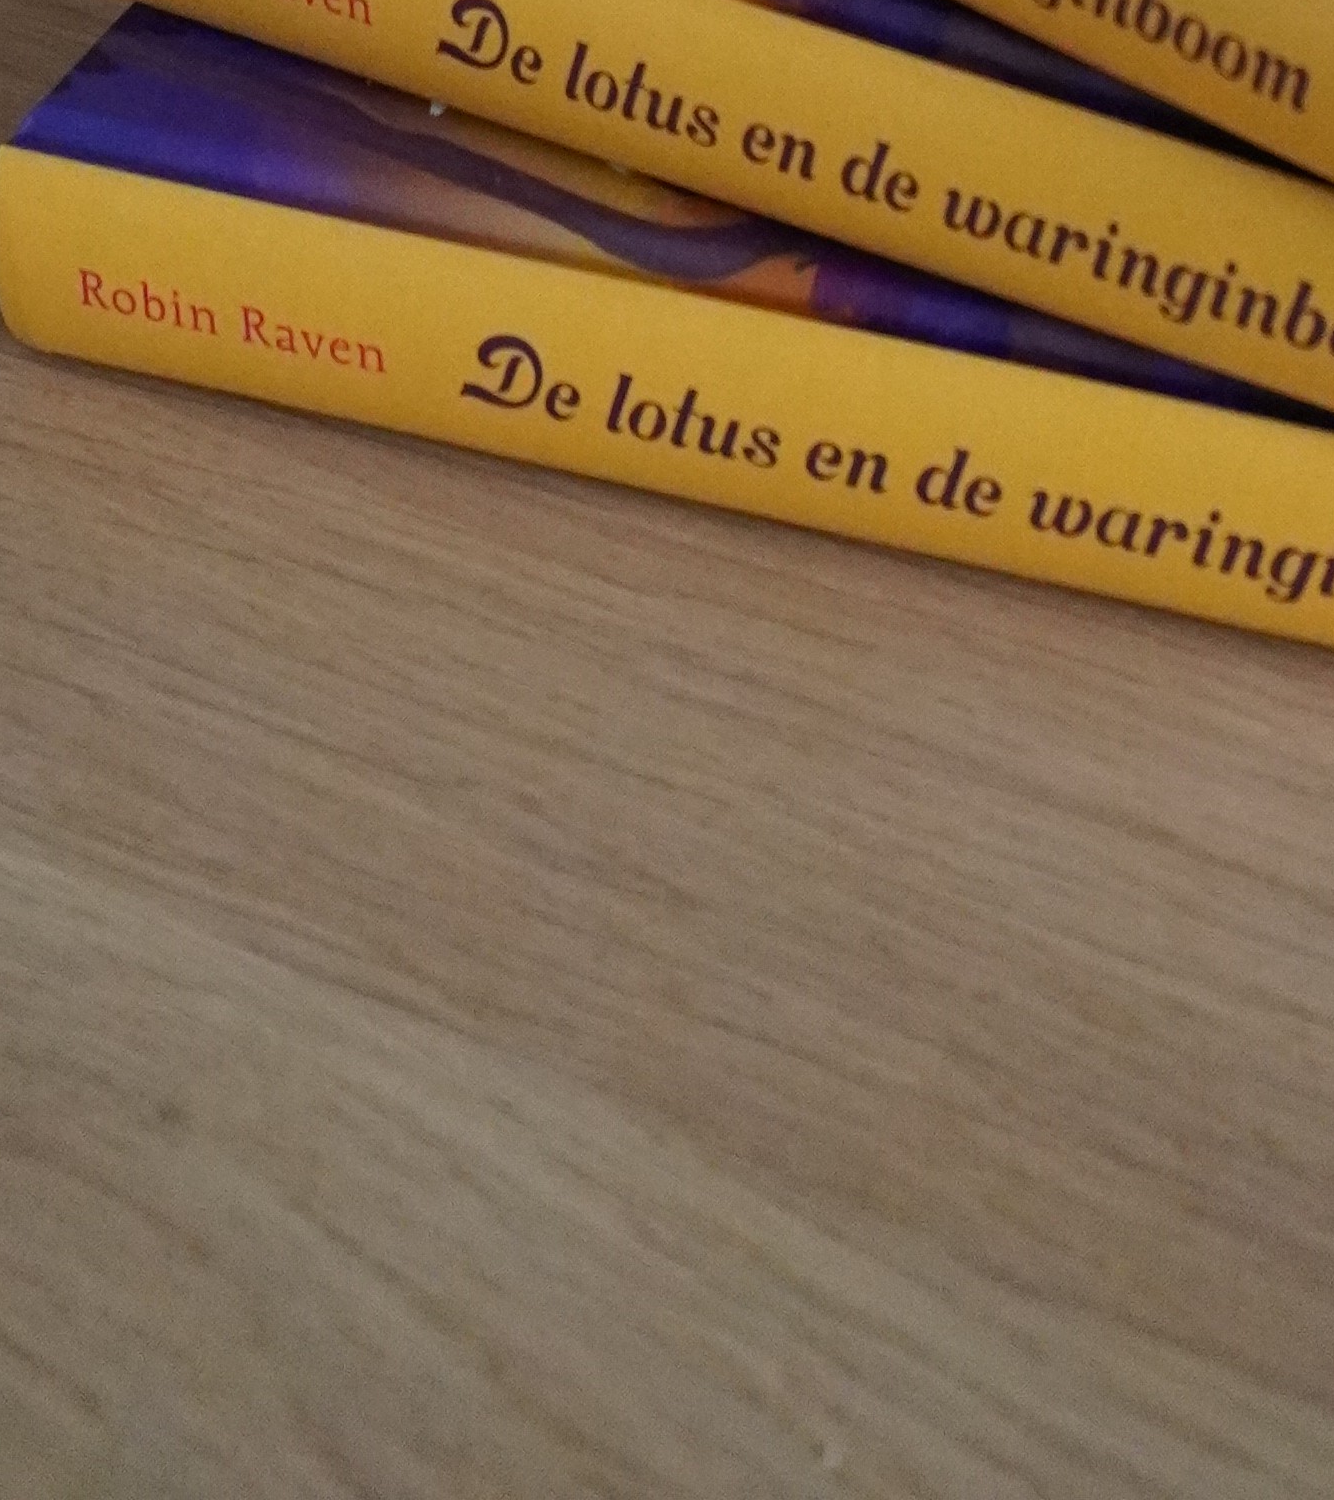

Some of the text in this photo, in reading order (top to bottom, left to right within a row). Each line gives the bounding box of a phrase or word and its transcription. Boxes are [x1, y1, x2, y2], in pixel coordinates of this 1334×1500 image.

[566, 41, 719, 148] lotus
[741, 121, 818, 182] en
[840, 140, 923, 213] de
[78, 268, 387, 375] Robin Raven
[460, 334, 581, 422] De
[607, 374, 783, 471] lotus
[804, 428, 889, 497] en
[914, 448, 1005, 518] de
